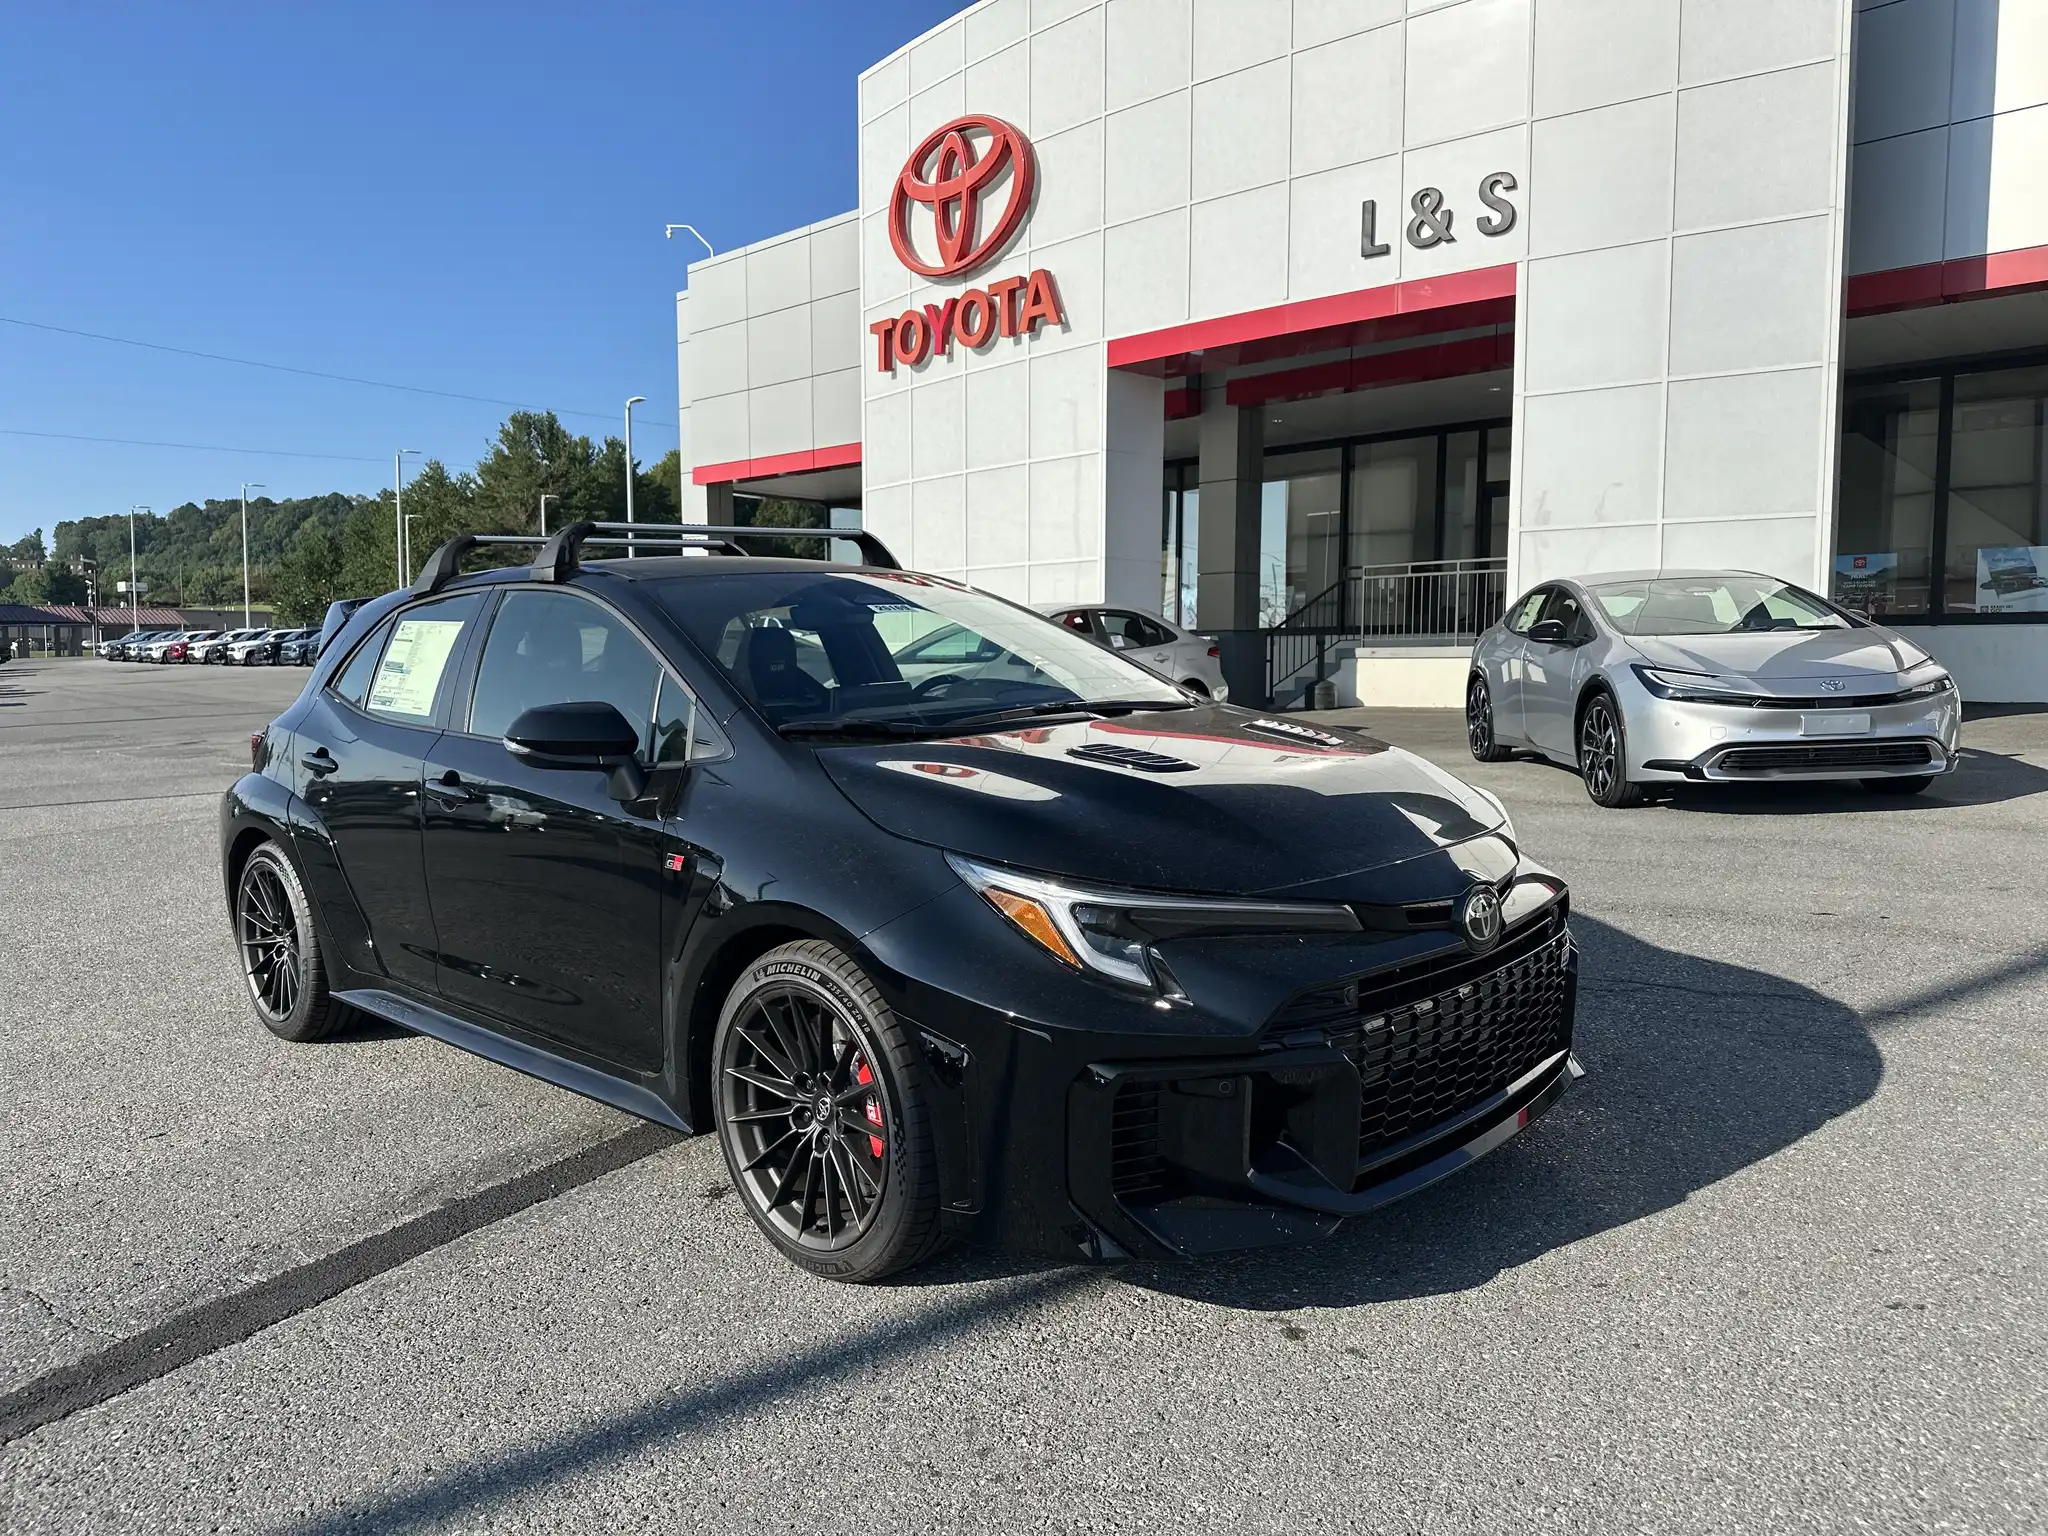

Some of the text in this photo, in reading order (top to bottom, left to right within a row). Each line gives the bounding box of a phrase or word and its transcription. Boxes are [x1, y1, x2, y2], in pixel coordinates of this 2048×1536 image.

[1361, 171, 1518, 259] L & S
[870, 268, 1064, 372] TOYOTA
[766, 963, 822, 982] MICHELIN
[826, 982, 853, 1008] 235/40
[852, 1008, 863, 1021] ZR
